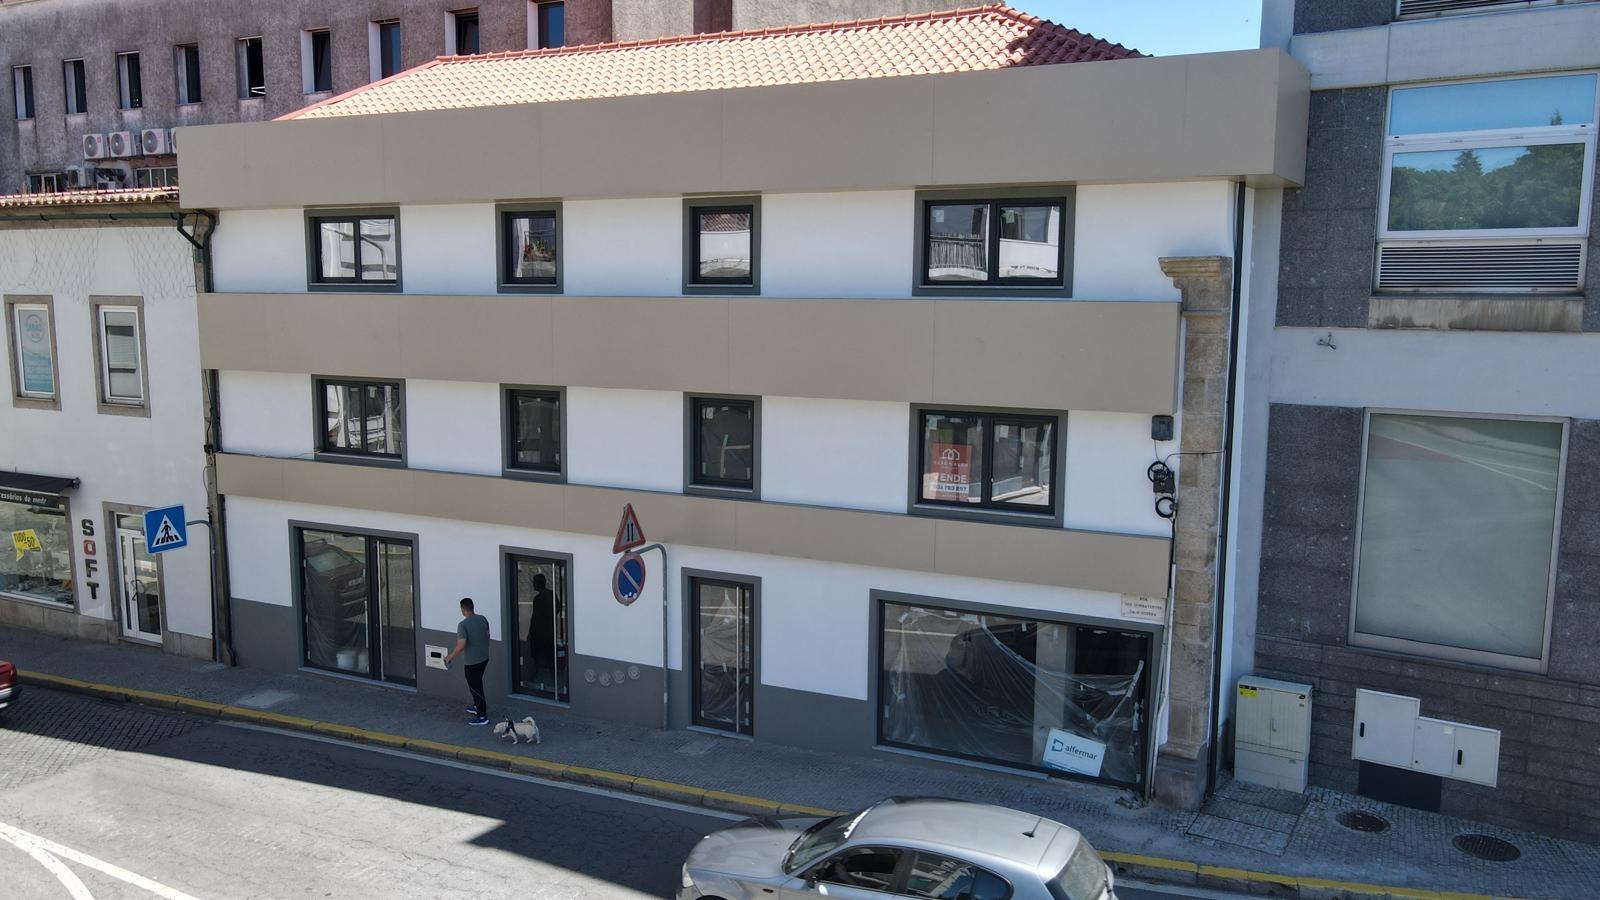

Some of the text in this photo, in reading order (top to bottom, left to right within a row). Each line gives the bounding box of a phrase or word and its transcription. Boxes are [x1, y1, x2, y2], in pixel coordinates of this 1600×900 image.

[936, 472, 968, 483] ENDE
[81, 518, 99, 599] SOFT
[1065, 745, 1097, 760] alfermar
